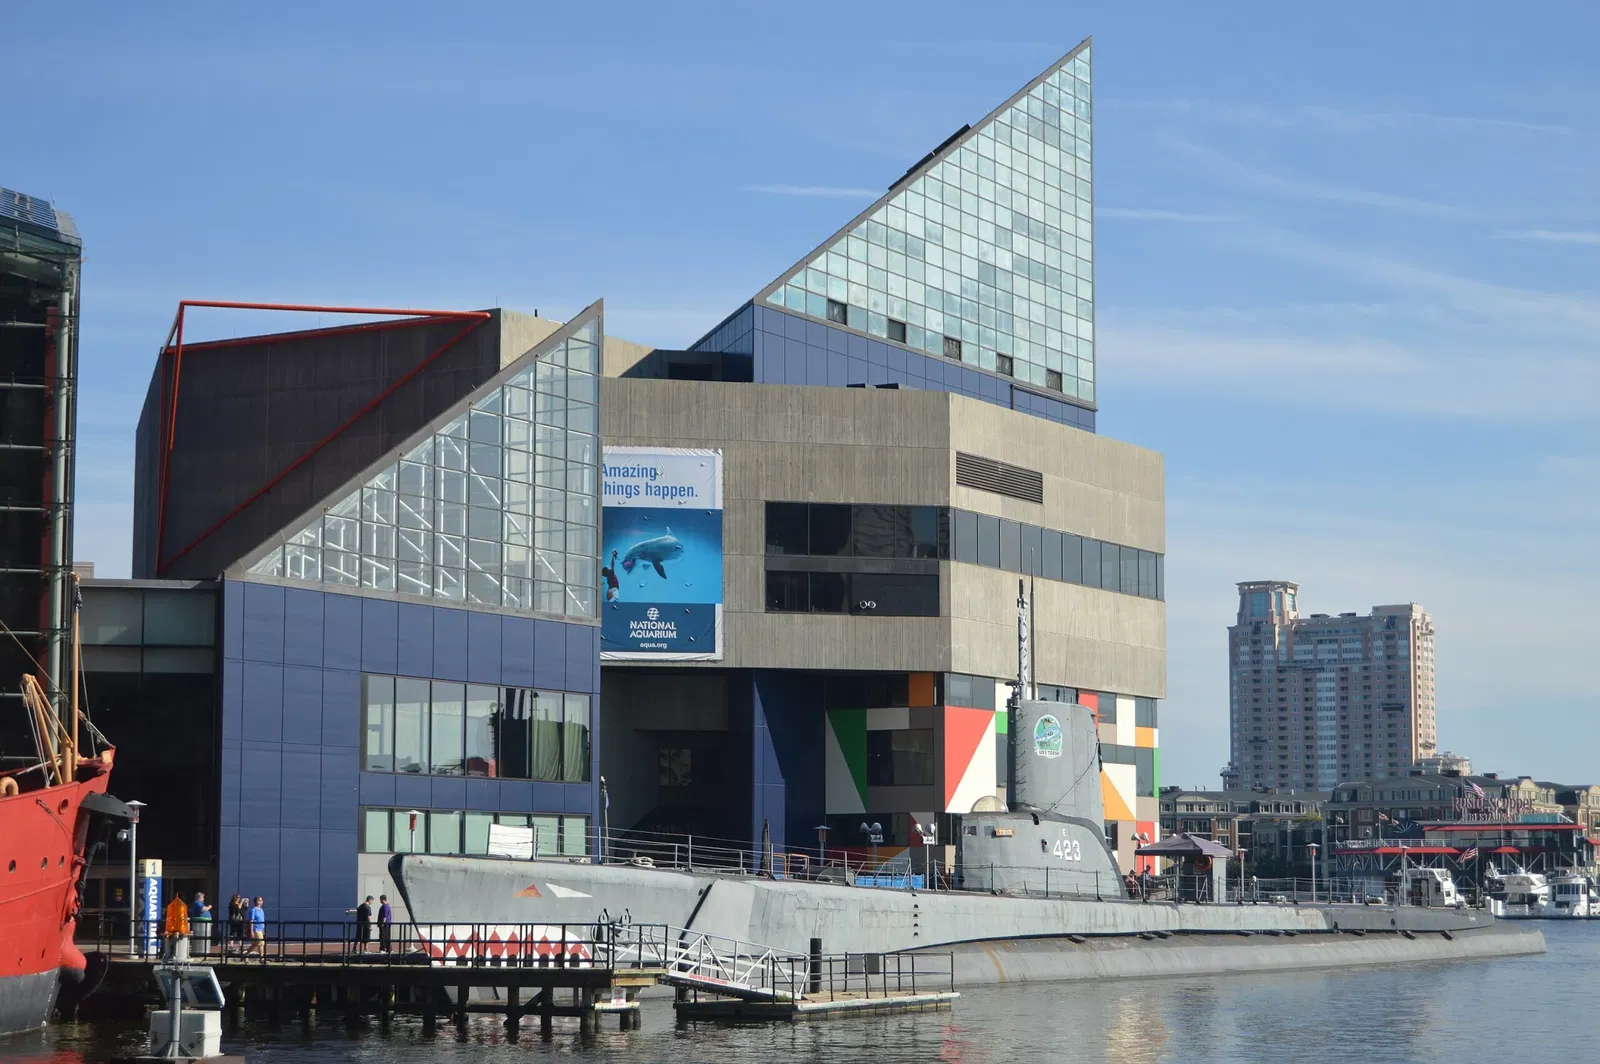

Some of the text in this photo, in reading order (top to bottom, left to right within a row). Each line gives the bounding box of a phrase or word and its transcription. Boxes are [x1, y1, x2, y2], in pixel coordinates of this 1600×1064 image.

[602, 463, 656, 481] Amazing
[602, 481, 698, 499] hings happen.
[630, 621, 677, 630] NATIONAL
[630, 630, 677, 639] AQUARIUM
[1062, 828, 1067, 837] E
[1053, 840, 1081, 861] 423
[151, 861, 157, 875] 1
